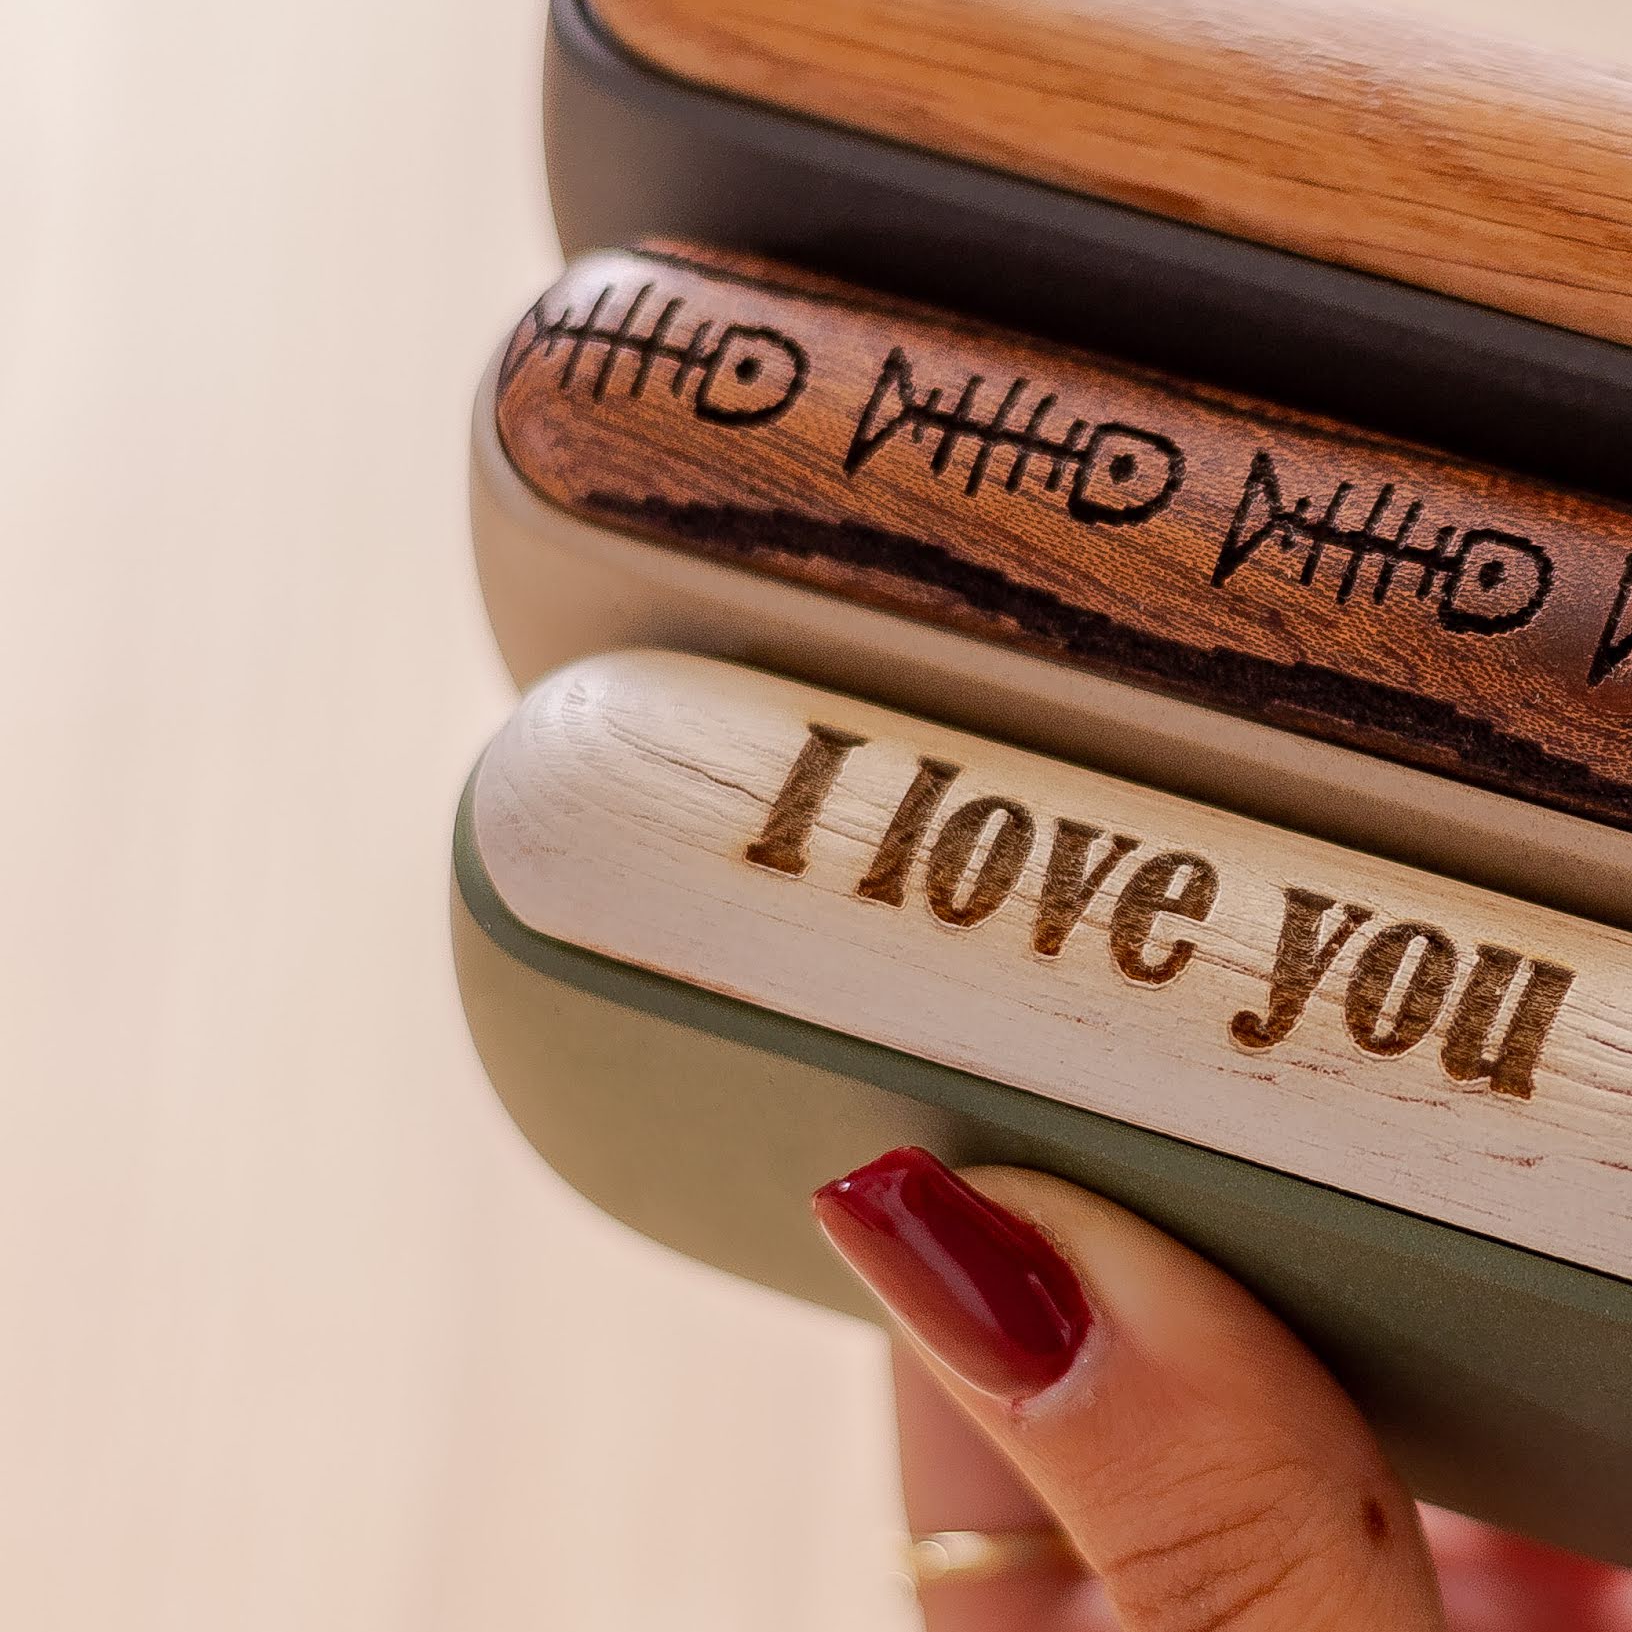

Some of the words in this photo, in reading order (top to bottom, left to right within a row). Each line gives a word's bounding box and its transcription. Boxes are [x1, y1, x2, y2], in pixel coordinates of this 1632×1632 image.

[744, 722, 868, 875] I
[856, 755, 1220, 987] love
[1228, 886, 1577, 1099] you
